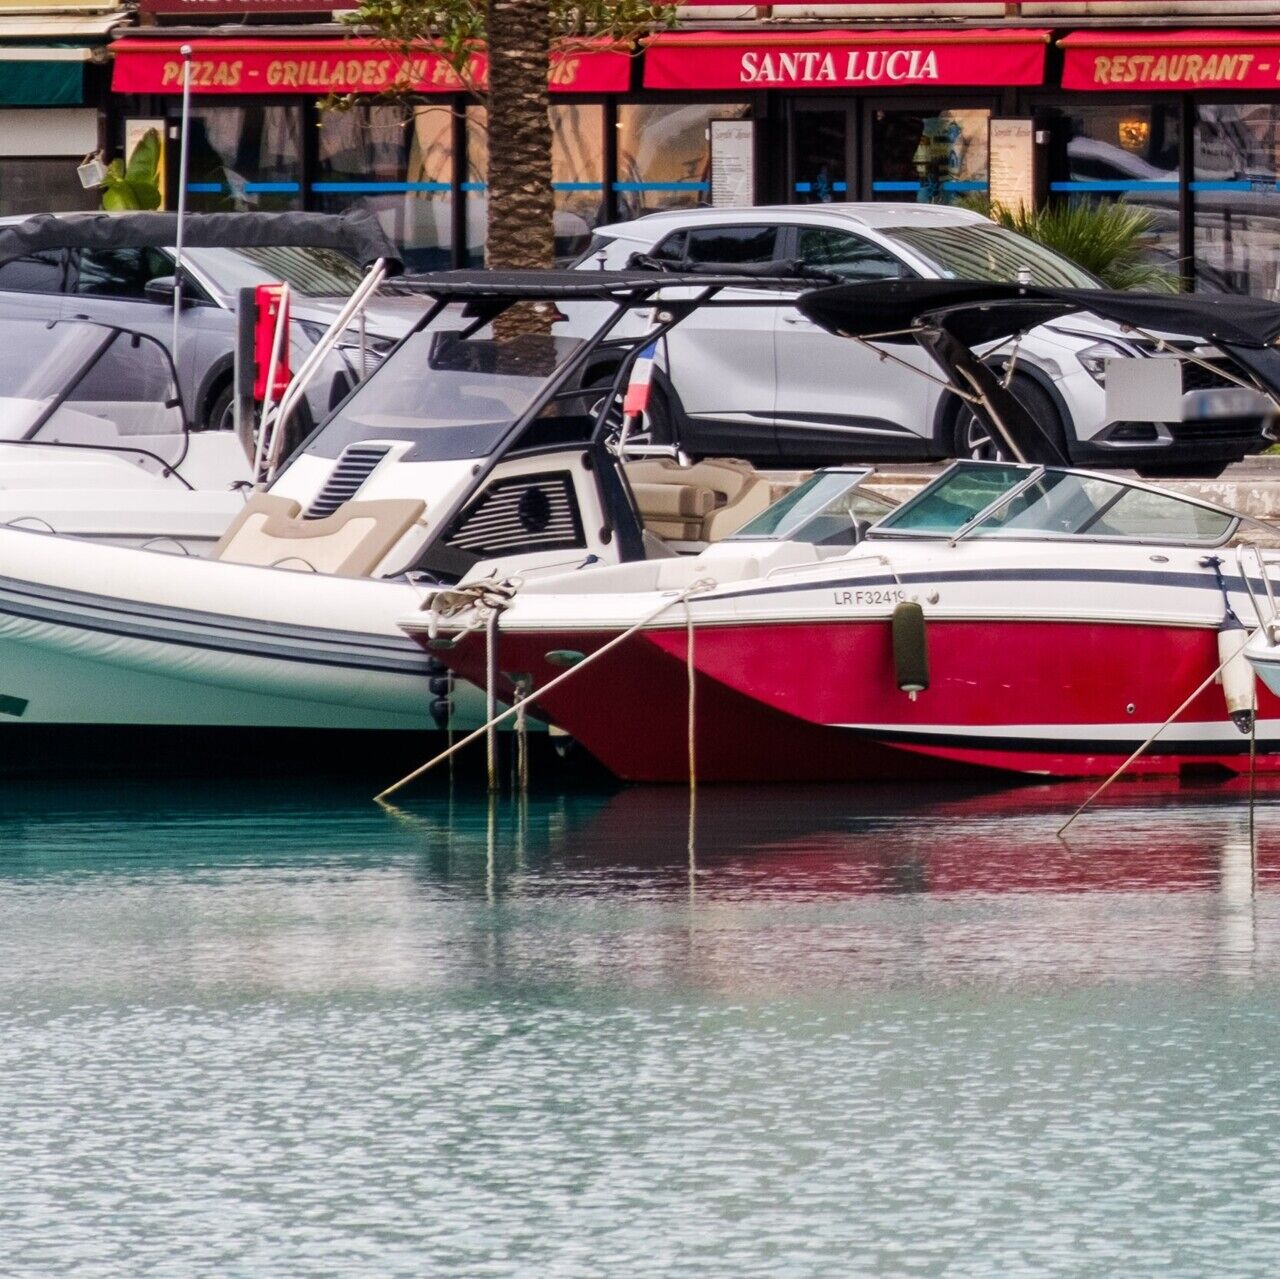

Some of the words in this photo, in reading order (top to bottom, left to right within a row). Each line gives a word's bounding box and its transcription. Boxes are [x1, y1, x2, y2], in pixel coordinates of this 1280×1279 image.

[266, 60, 390, 86] GRILLADES
[740, 51, 837, 84] SANTA
[844, 49, 940, 82] LUCIA
[1093, 54, 1255, 84] RESTAURANT
